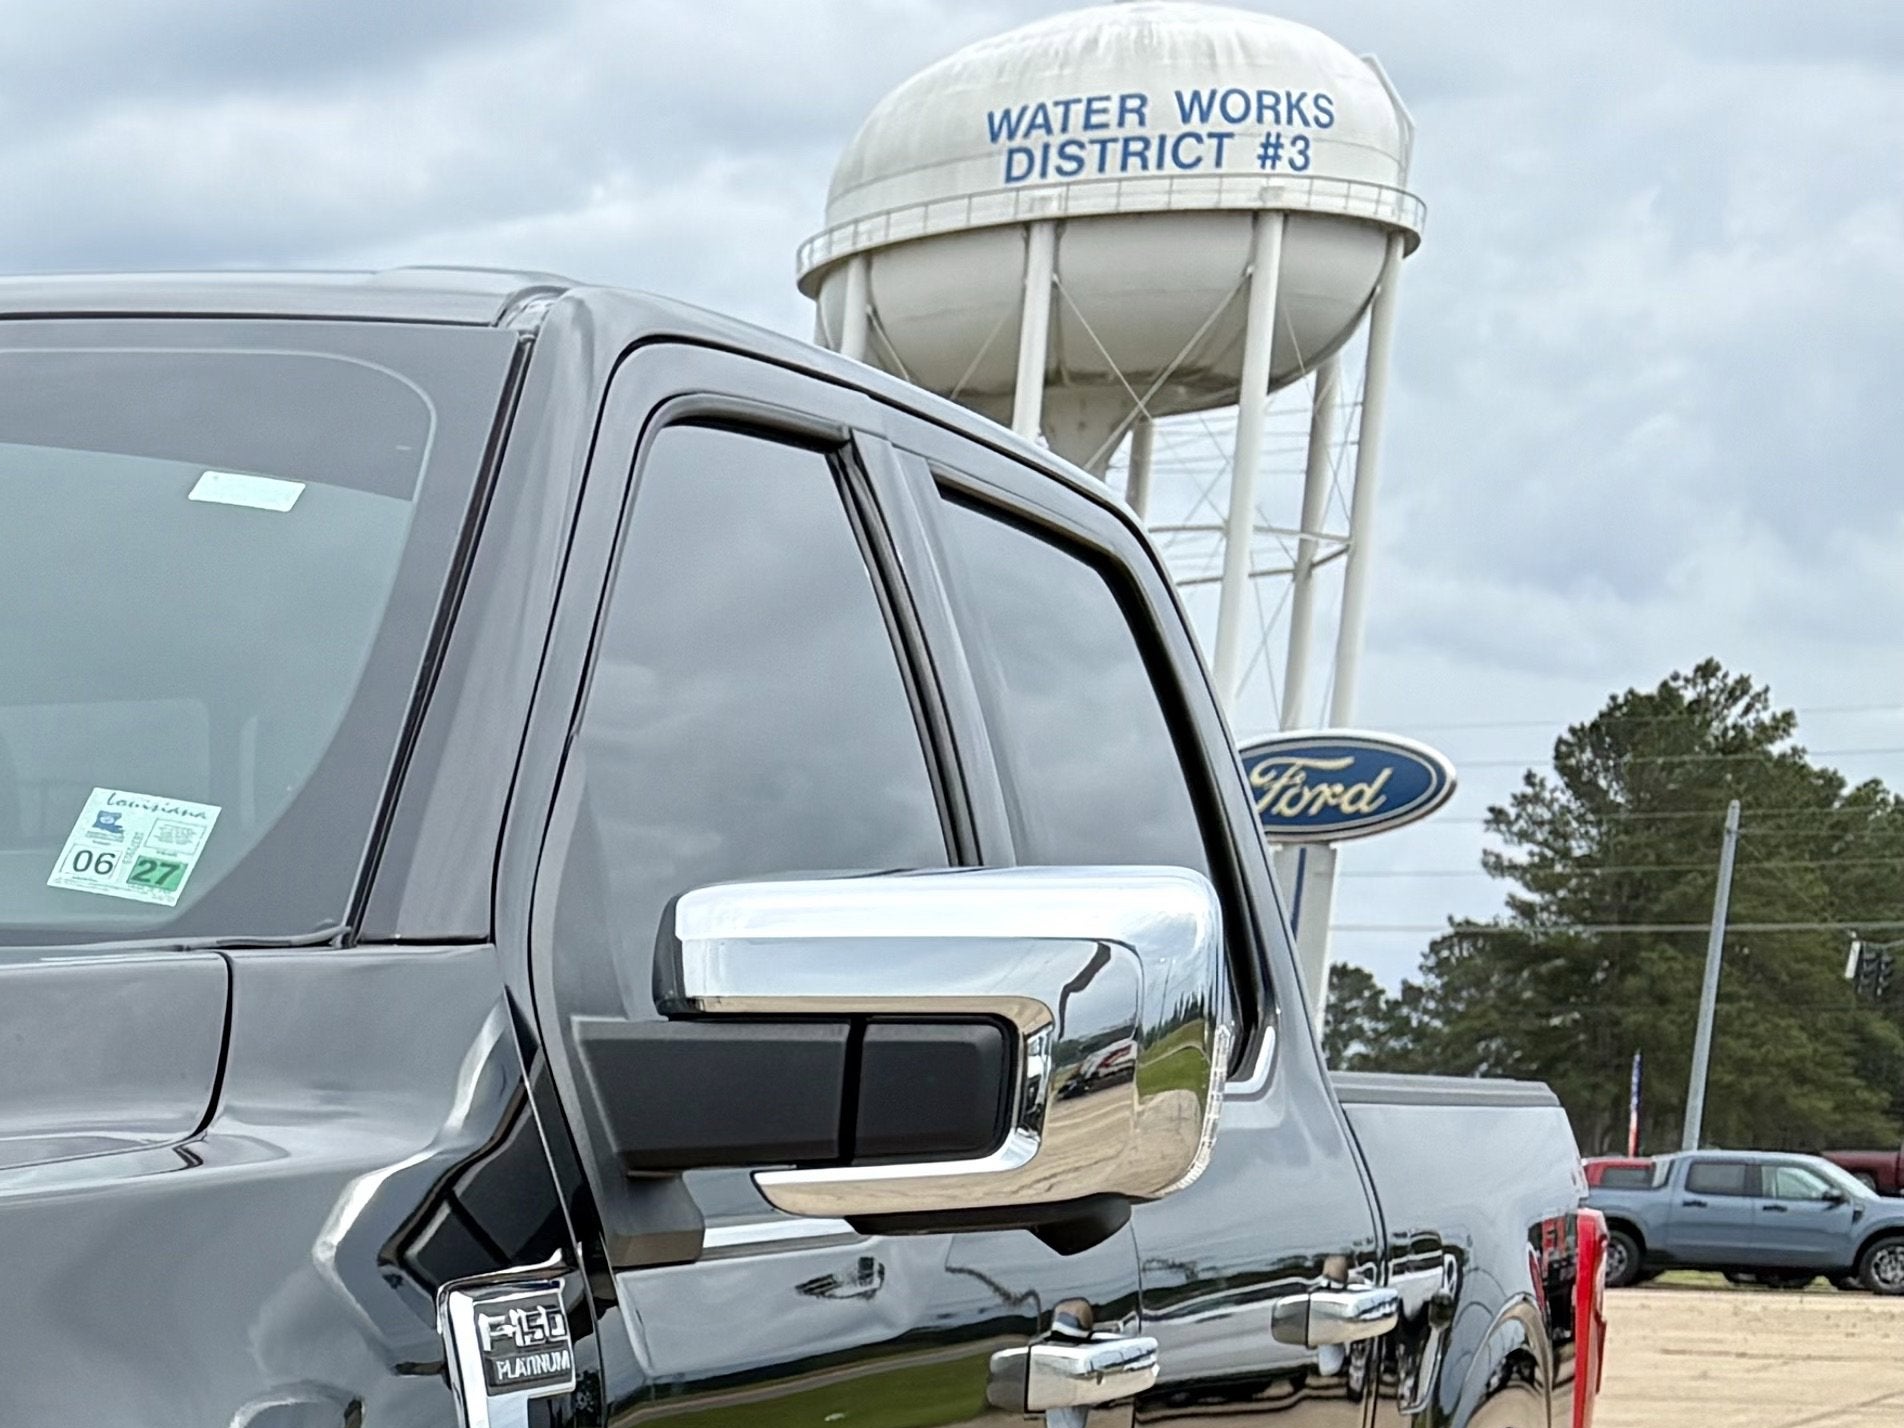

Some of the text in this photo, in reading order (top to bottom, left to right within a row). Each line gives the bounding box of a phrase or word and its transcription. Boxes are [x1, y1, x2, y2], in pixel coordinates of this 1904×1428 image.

[986, 88, 1336, 143] WATER WORKS
[1003, 131, 1312, 184] DISTRICT #3
[106, 791, 208, 820] Louisiana
[1249, 756, 1393, 817] Ford
[72, 849, 180, 886] 06 27
[477, 1305, 570, 1352] F-150
[495, 1349, 571, 1381] PLATINUM
